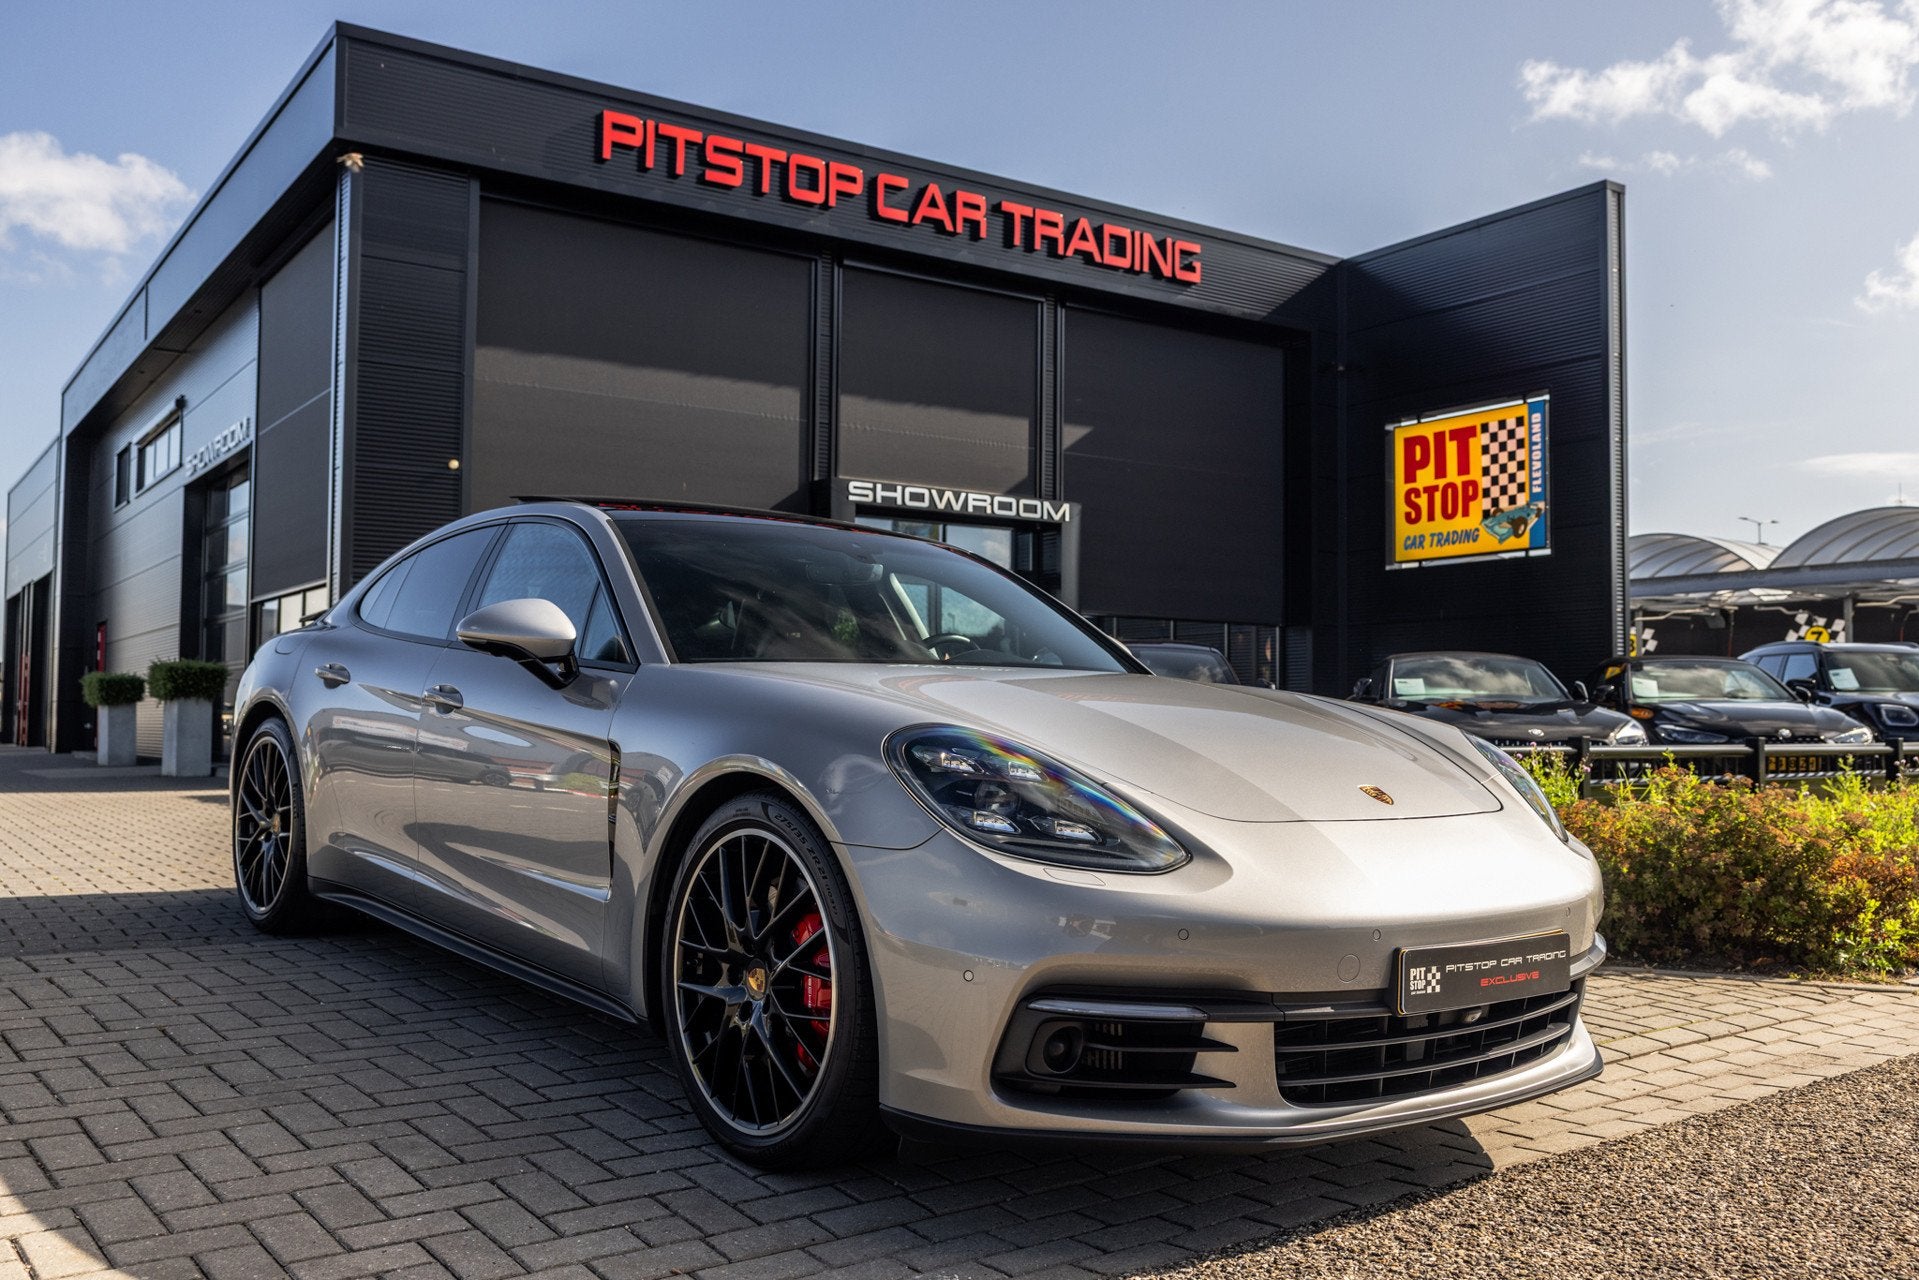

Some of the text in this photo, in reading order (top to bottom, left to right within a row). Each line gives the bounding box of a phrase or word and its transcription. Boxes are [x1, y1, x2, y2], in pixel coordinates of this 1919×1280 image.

[602, 110, 1201, 284] PITSTOP CAR TRADING
[1403, 425, 1477, 484] PIT
[1531, 412, 1542, 493] FLEVOLAND
[848, 481, 1070, 522] SHOWROOM
[1404, 480, 1479, 525] STOP
[1404, 527, 1480, 550] CAR TRADING
[1410, 967, 1426, 981] PIT
[1445, 950, 1567, 973] PITSTOP CAR TRADING
[1410, 980, 1426, 991] STOP
[1480, 971, 1540, 987] EXCLUSIVE
